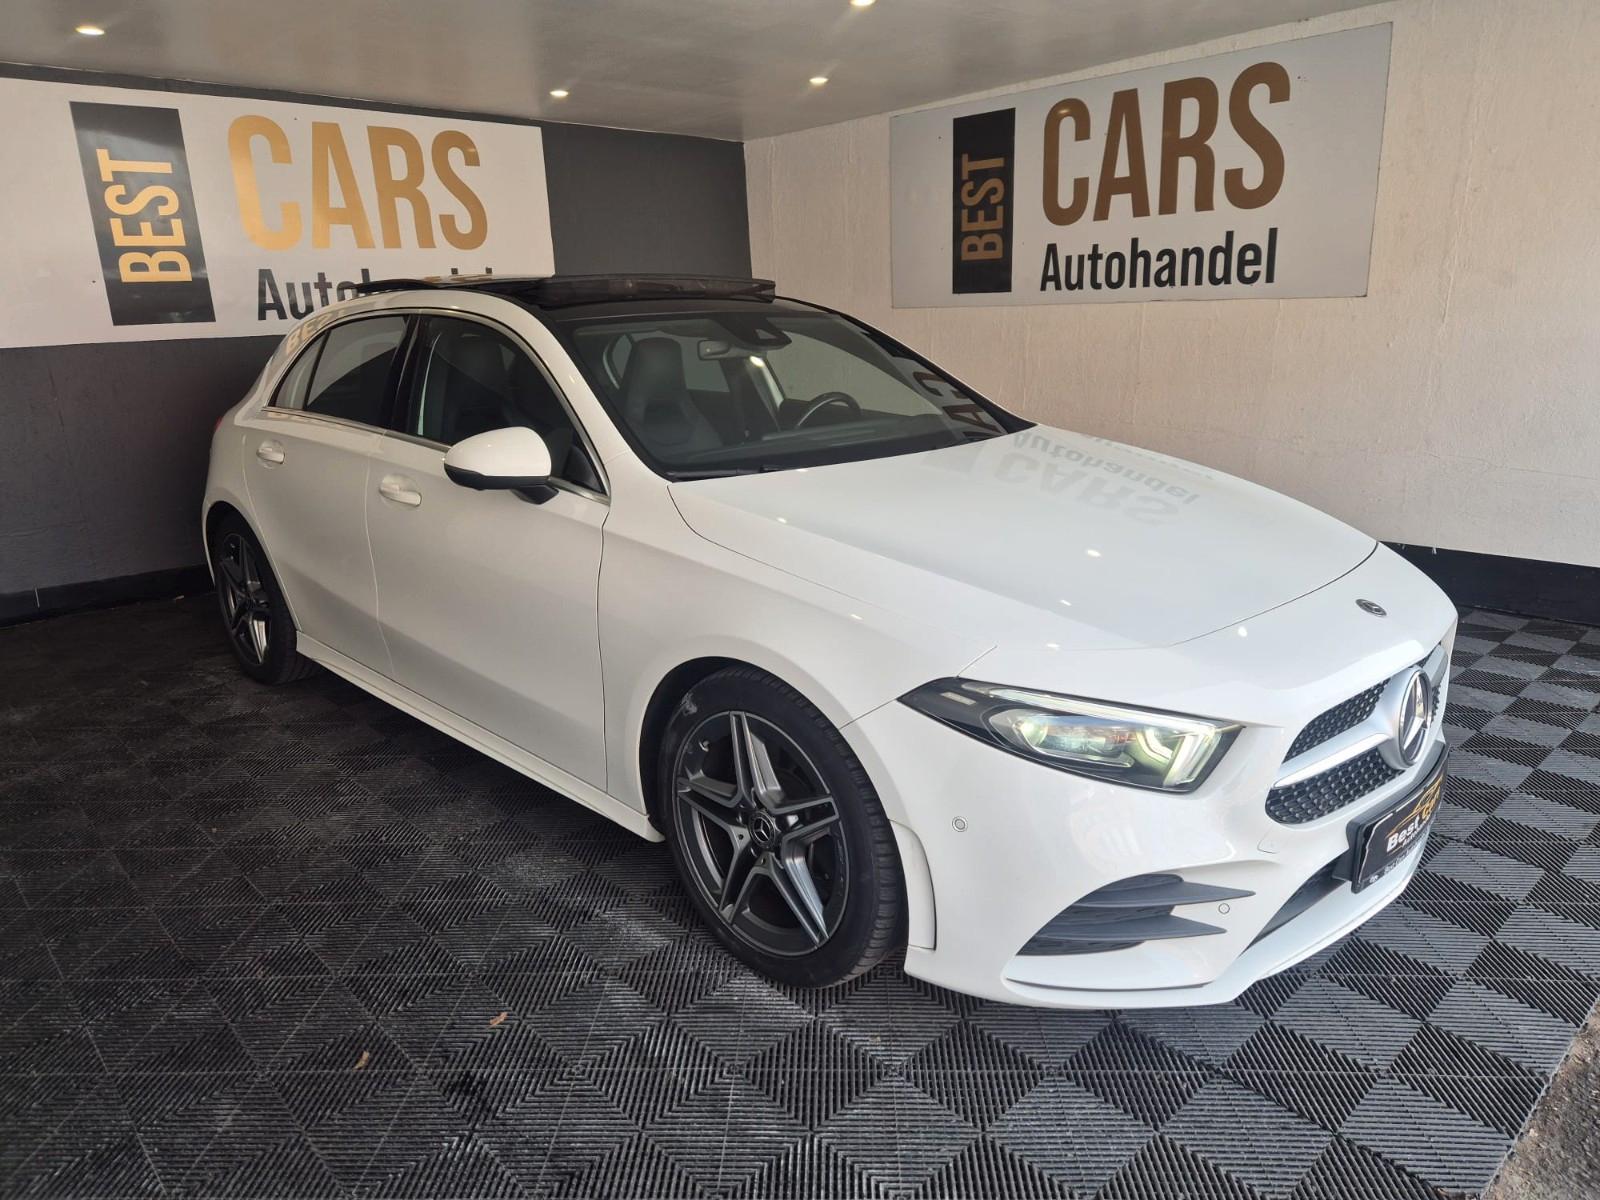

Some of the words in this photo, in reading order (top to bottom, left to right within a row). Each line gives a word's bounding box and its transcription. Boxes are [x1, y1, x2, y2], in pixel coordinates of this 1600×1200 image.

[227, 115, 488, 251] CARS
[1042, 62, 1291, 226] CARS
[96, 148, 193, 283] BEST
[960, 153, 1005, 261] BEST
[1040, 227, 1278, 291] Autohandel
[1386, 814, 1421, 853] Best
